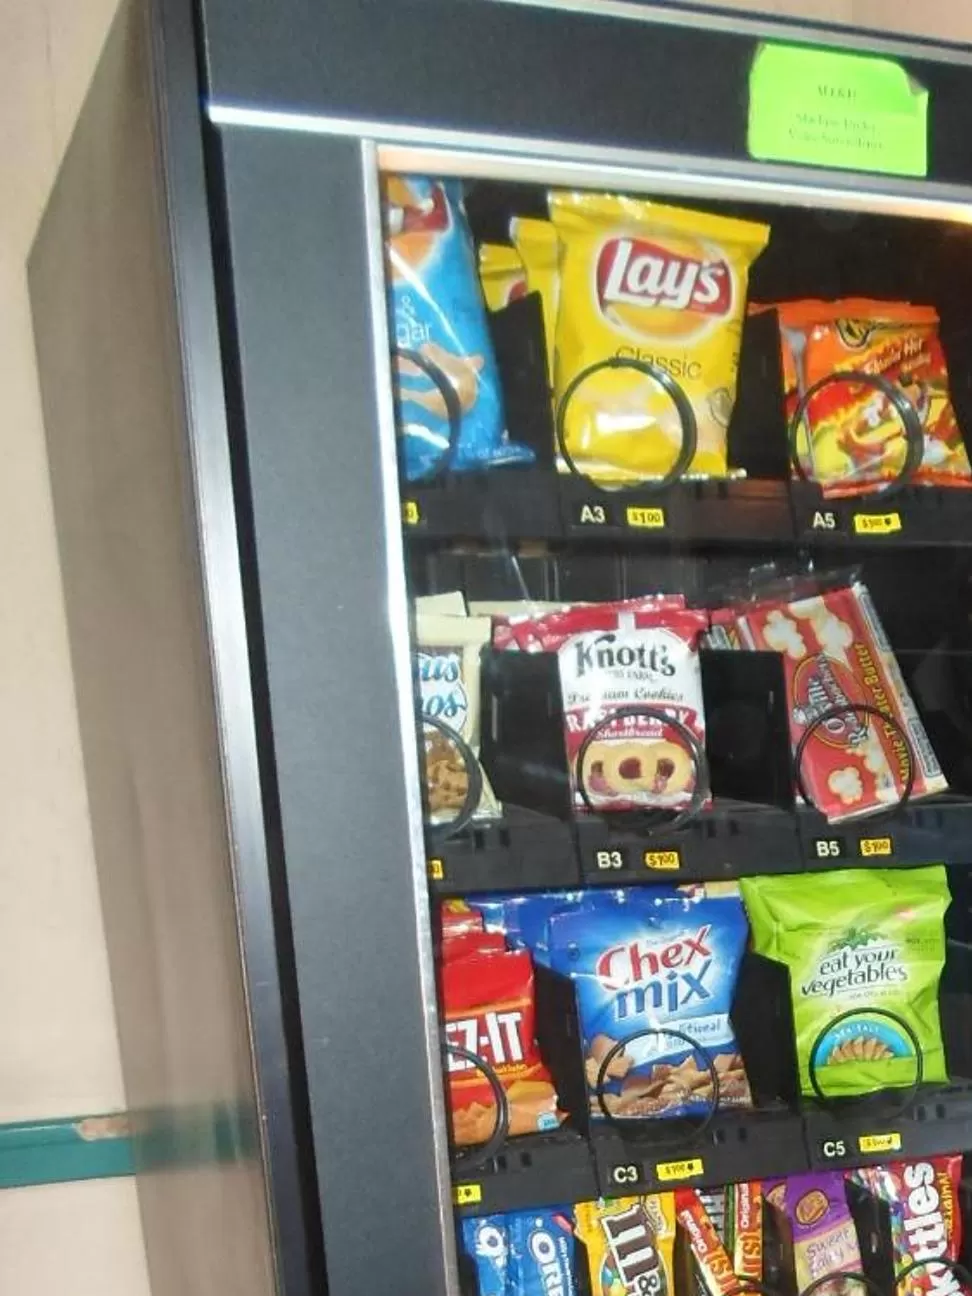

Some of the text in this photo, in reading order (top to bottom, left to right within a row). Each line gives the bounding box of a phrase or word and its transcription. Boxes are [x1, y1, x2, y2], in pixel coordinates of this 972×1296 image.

[603, 239, 726, 310] Lay's
[615, 345, 702, 380] Classic
[580, 504, 606, 524] A3
[813, 510, 836, 529] A5
[575, 634, 677, 679] Knott's
[597, 851, 623, 869] B3
[816, 840, 841, 857] B5
[596, 924, 713, 991] Chex
[820, 949, 897, 976] eat your
[613, 957, 713, 1021] mix
[801, 961, 908, 997] vegetables
[446, 1011, 524, 1072] EZ-IT
[823, 1140, 846, 1157] C5
[613, 1165, 639, 1183] C3
